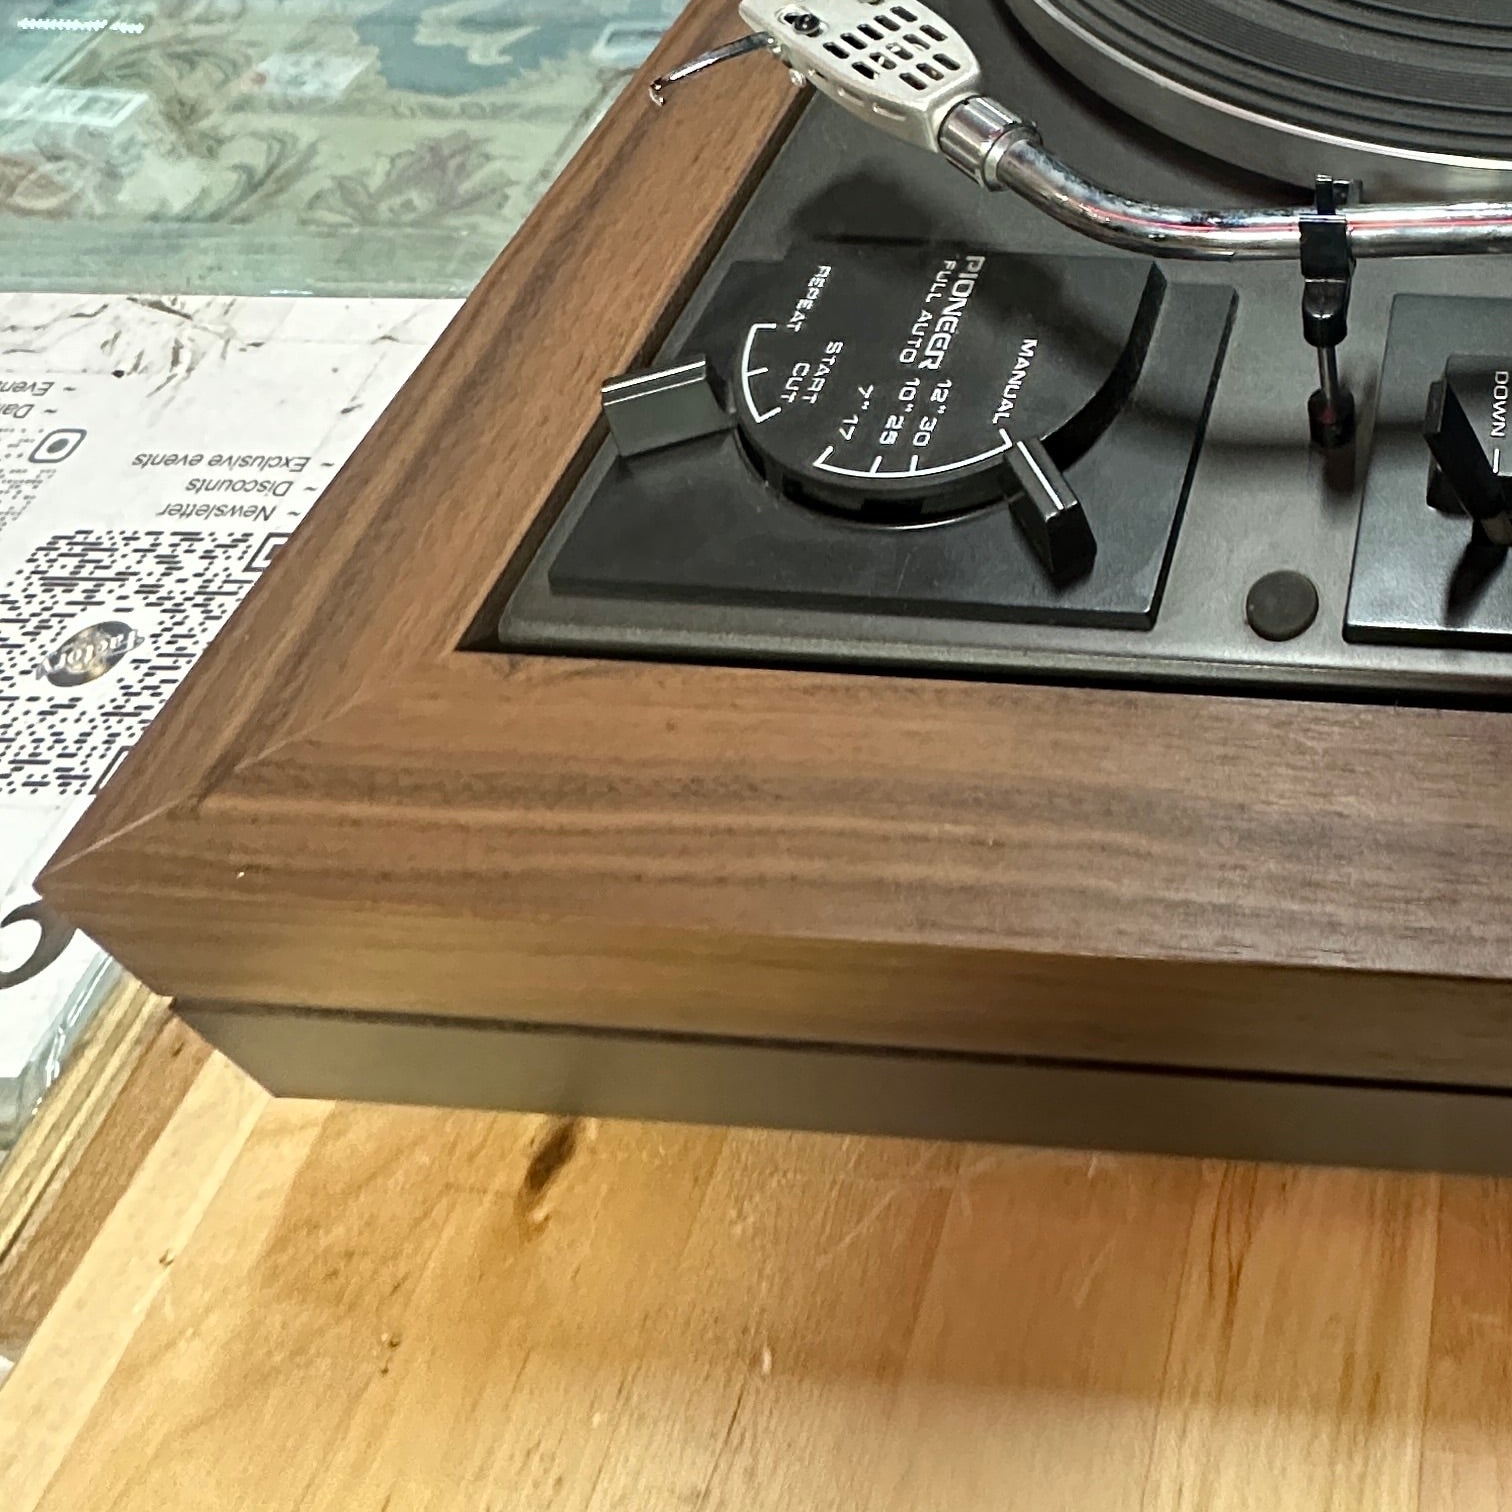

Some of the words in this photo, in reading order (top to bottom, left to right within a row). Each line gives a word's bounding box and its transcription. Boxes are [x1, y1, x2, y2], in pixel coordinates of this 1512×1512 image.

[786, 265, 832, 333] REPEAT
[925, 260, 957, 303] FULL
[918, 255, 986, 370] PIONEER
[899, 309, 933, 364] AUTO
[0, 380, 55, 396] Even
[780, 362, 811, 403] CUT
[802, 341, 844, 405] START
[992, 339, 1038, 424] MANUAL
[1490, 371, 1509, 437] DOWN
[839, 414, 858, 441] 17
[879, 414, 904, 445] 25
[913, 416, 938, 447] 30
[132, 452, 203, 467] events
[207, 454, 311, 472] Exclusive
[185, 478, 294, 496] Discounts
[155, 502, 276, 522] Newsletter
